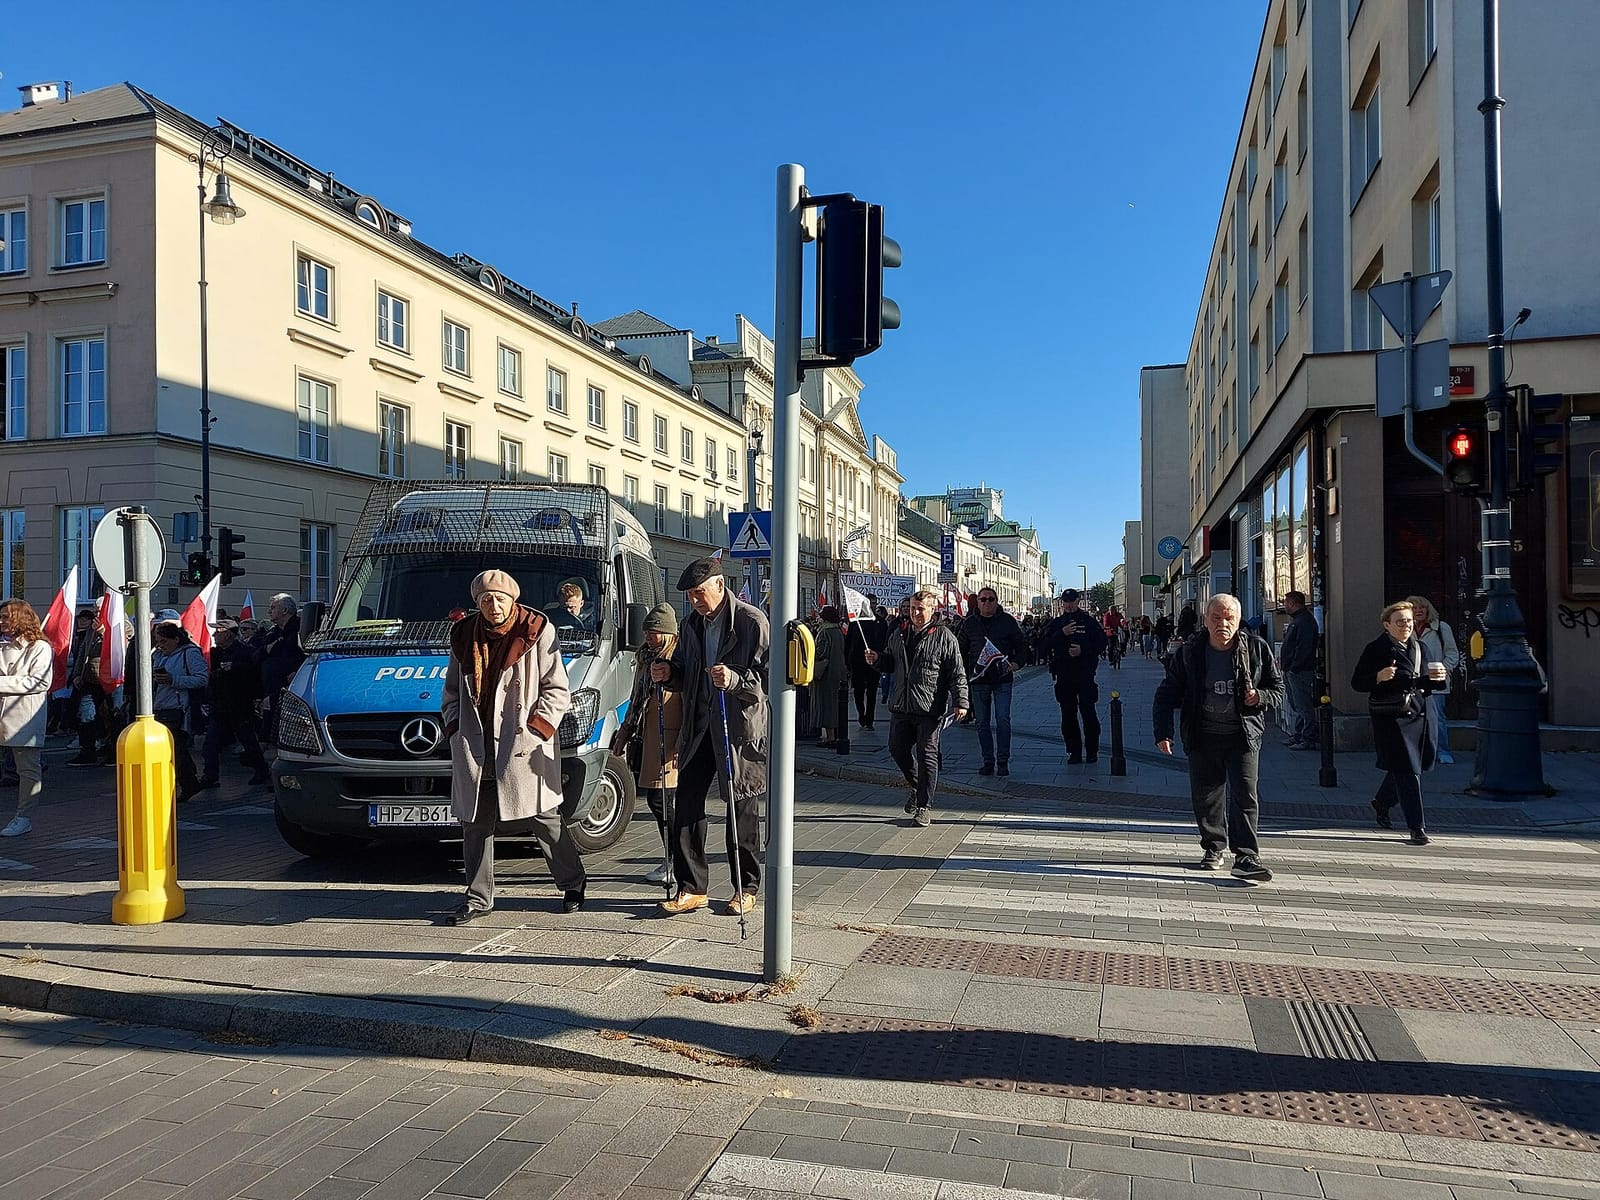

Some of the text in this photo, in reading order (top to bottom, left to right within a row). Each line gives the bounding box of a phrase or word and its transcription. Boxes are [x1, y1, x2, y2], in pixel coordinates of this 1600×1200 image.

[1449, 375, 1461, 389] ga
[943, 536, 952, 548] P
[943, 553, 952, 565] P
[374, 666, 449, 681] POLI
[380, 806, 458, 822] HPZ B61
